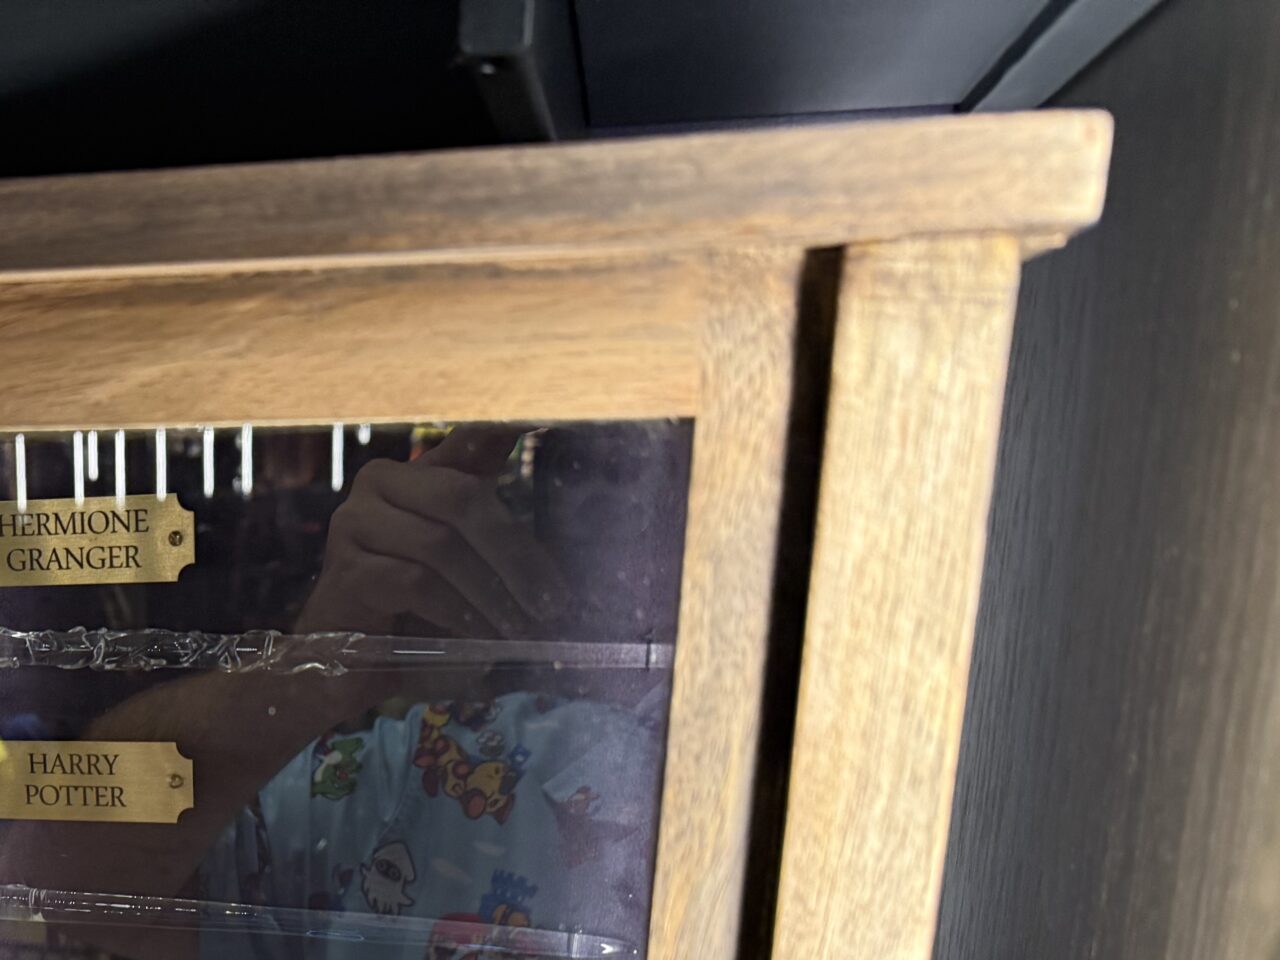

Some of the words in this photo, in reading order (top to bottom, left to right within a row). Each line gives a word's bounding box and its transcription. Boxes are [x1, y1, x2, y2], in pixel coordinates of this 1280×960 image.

[6, 545, 142, 572] GRANGER
[28, 752, 120, 776] HARRY
[24, 784, 127, 808] POTTER
